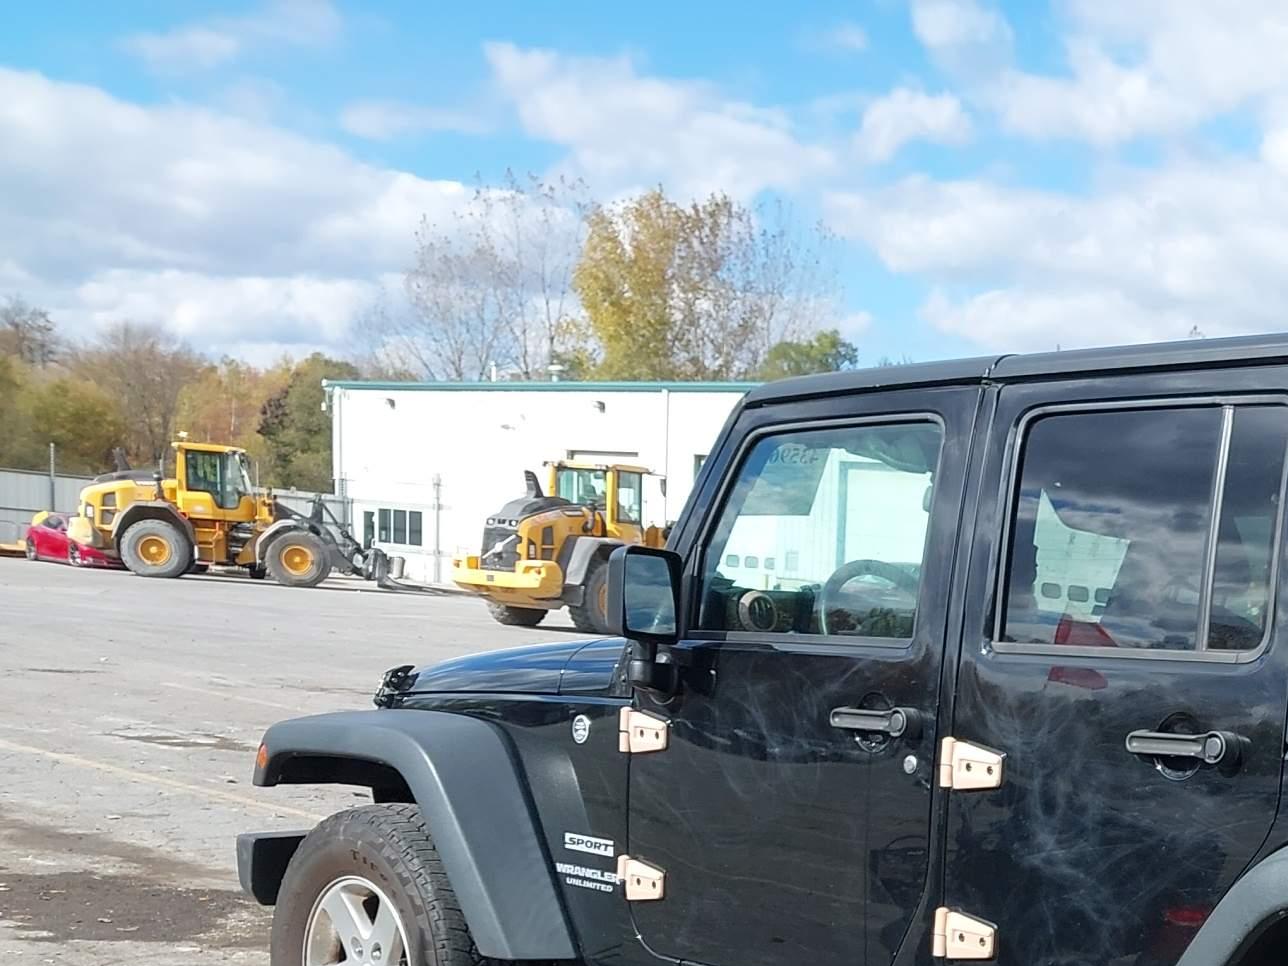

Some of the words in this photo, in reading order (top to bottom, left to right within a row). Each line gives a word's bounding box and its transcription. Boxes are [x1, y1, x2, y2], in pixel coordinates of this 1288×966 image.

[564, 836, 614, 852] SPORT
[555, 862, 620, 885] WRANGLER
[565, 876, 613, 893] UNLIMITED
